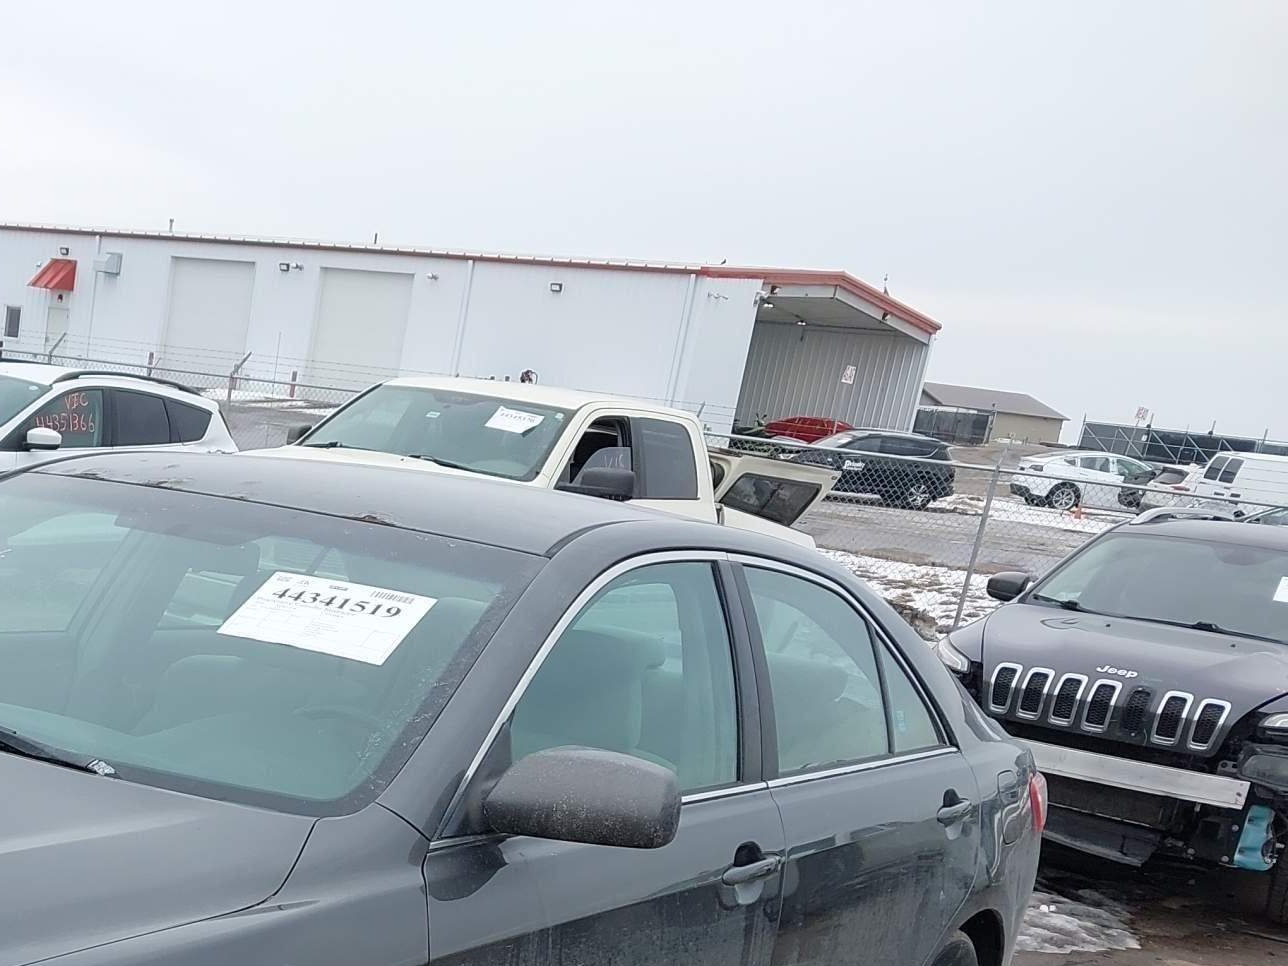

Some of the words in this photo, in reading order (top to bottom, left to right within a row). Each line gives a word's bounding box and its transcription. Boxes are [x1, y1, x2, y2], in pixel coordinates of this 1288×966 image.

[64, 392, 89, 410] VIC
[271, 587, 403, 619] 44341519
[1095, 665, 1138, 679] Jeep
